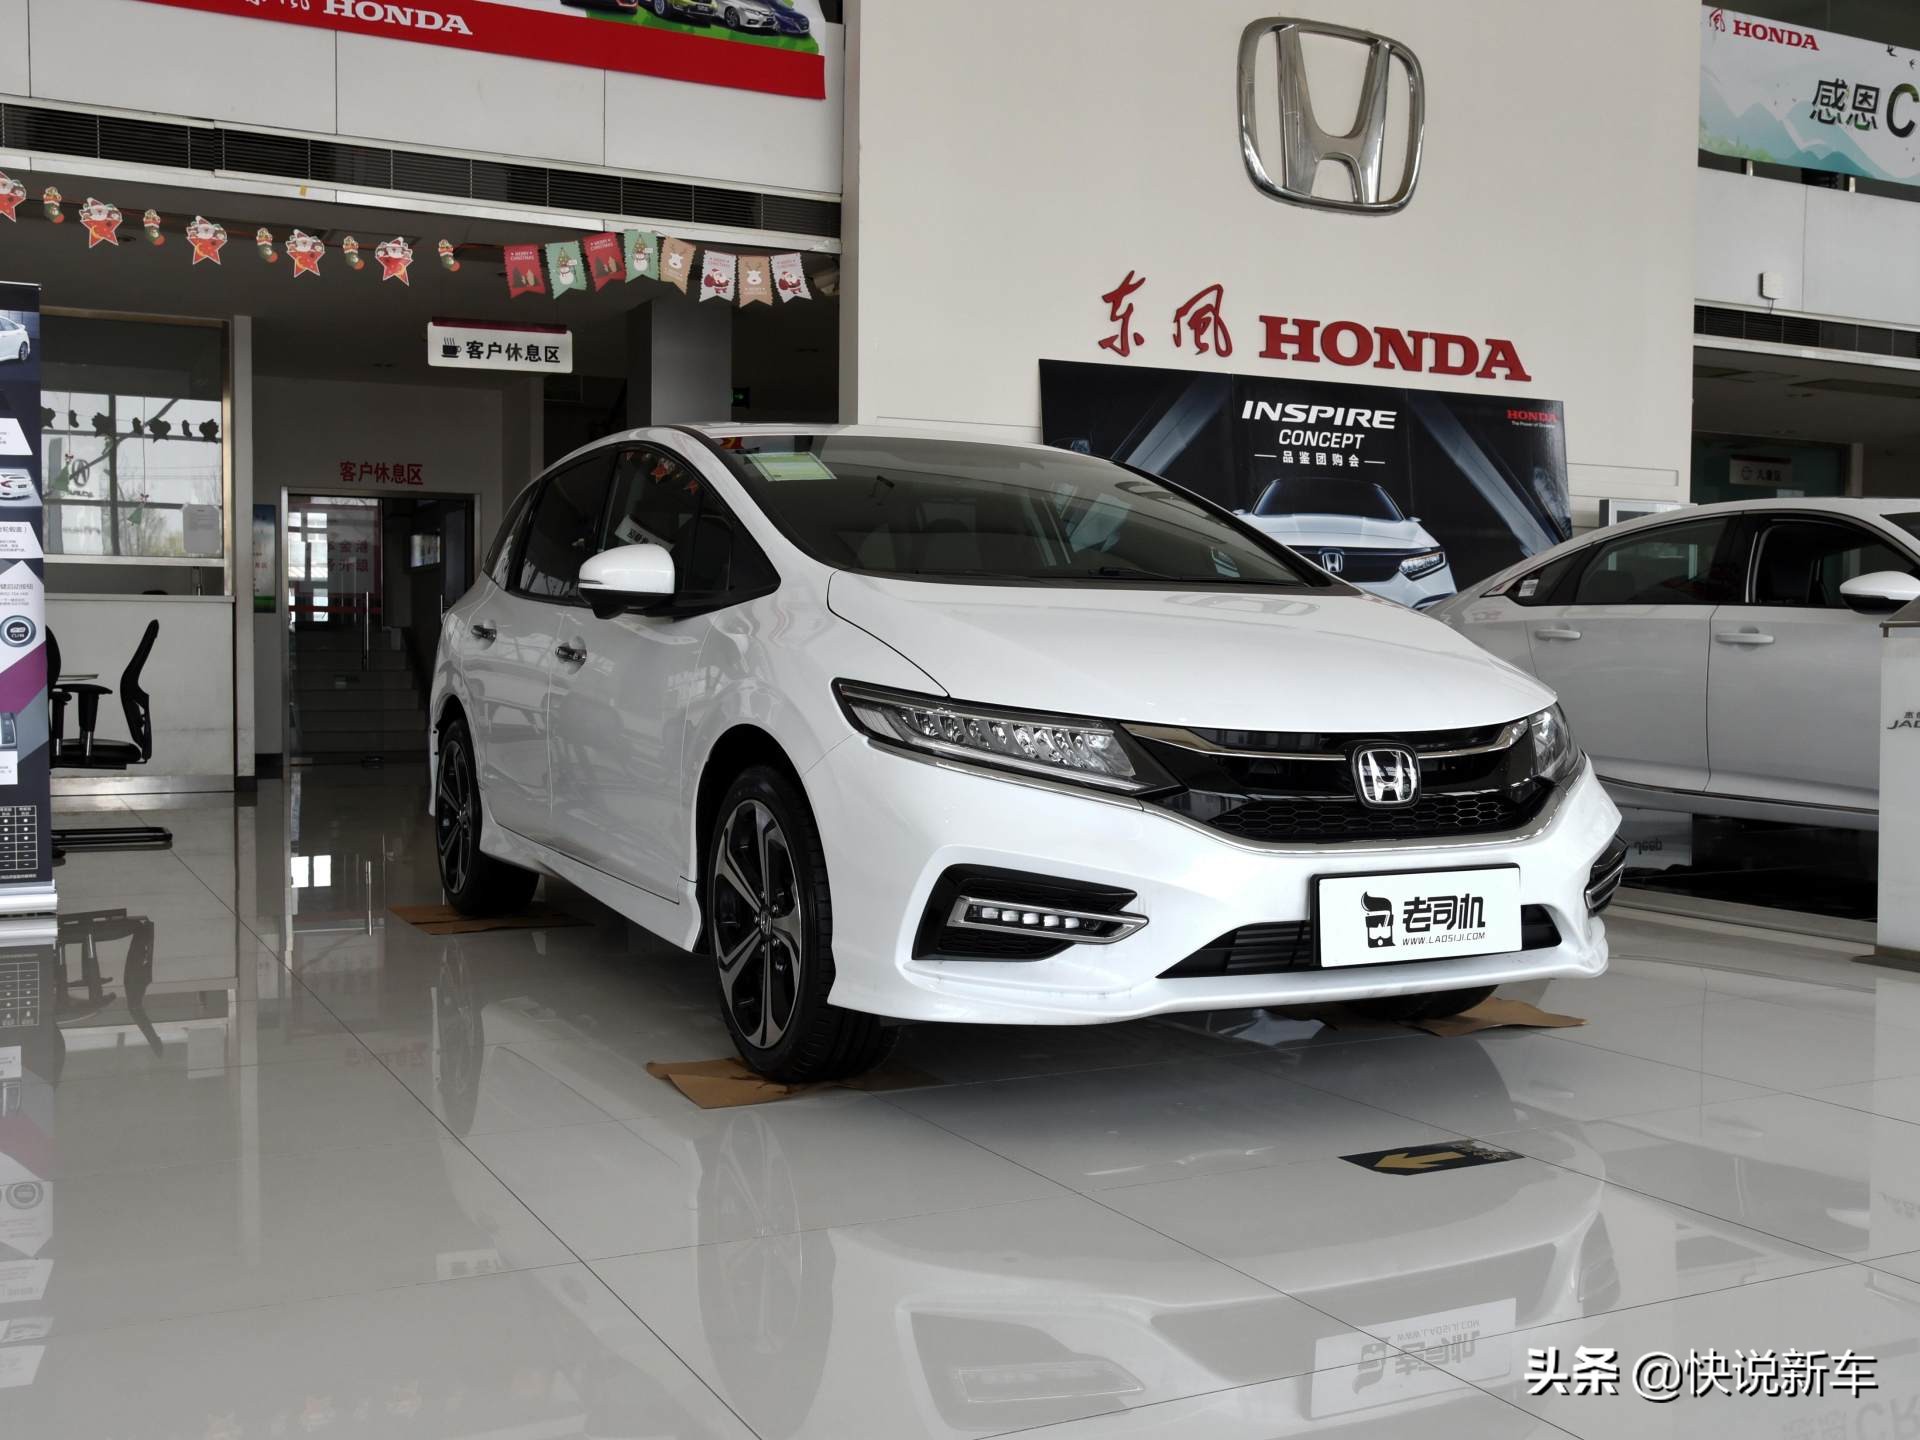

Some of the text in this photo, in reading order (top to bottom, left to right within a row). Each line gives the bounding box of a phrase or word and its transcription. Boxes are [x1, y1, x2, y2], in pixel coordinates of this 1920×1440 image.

[323, 0, 473, 36] HONDA
[1733, 19, 1820, 51] HONDA
[465, 340, 561, 363] 客户休息区
[1258, 314, 1532, 382] HONDA
[1241, 400, 1397, 430] INSPIRE
[1506, 410, 1558, 424] HONDA
[1279, 429, 1365, 449] CONCEPT
[1282, 450, 1360, 468] 品鉴团购会
[339, 461, 424, 485] 客户休息区
[1402, 892, 1487, 933] 老司机
[1402, 931, 1487, 946] WWW.LAOSIJI.COM
